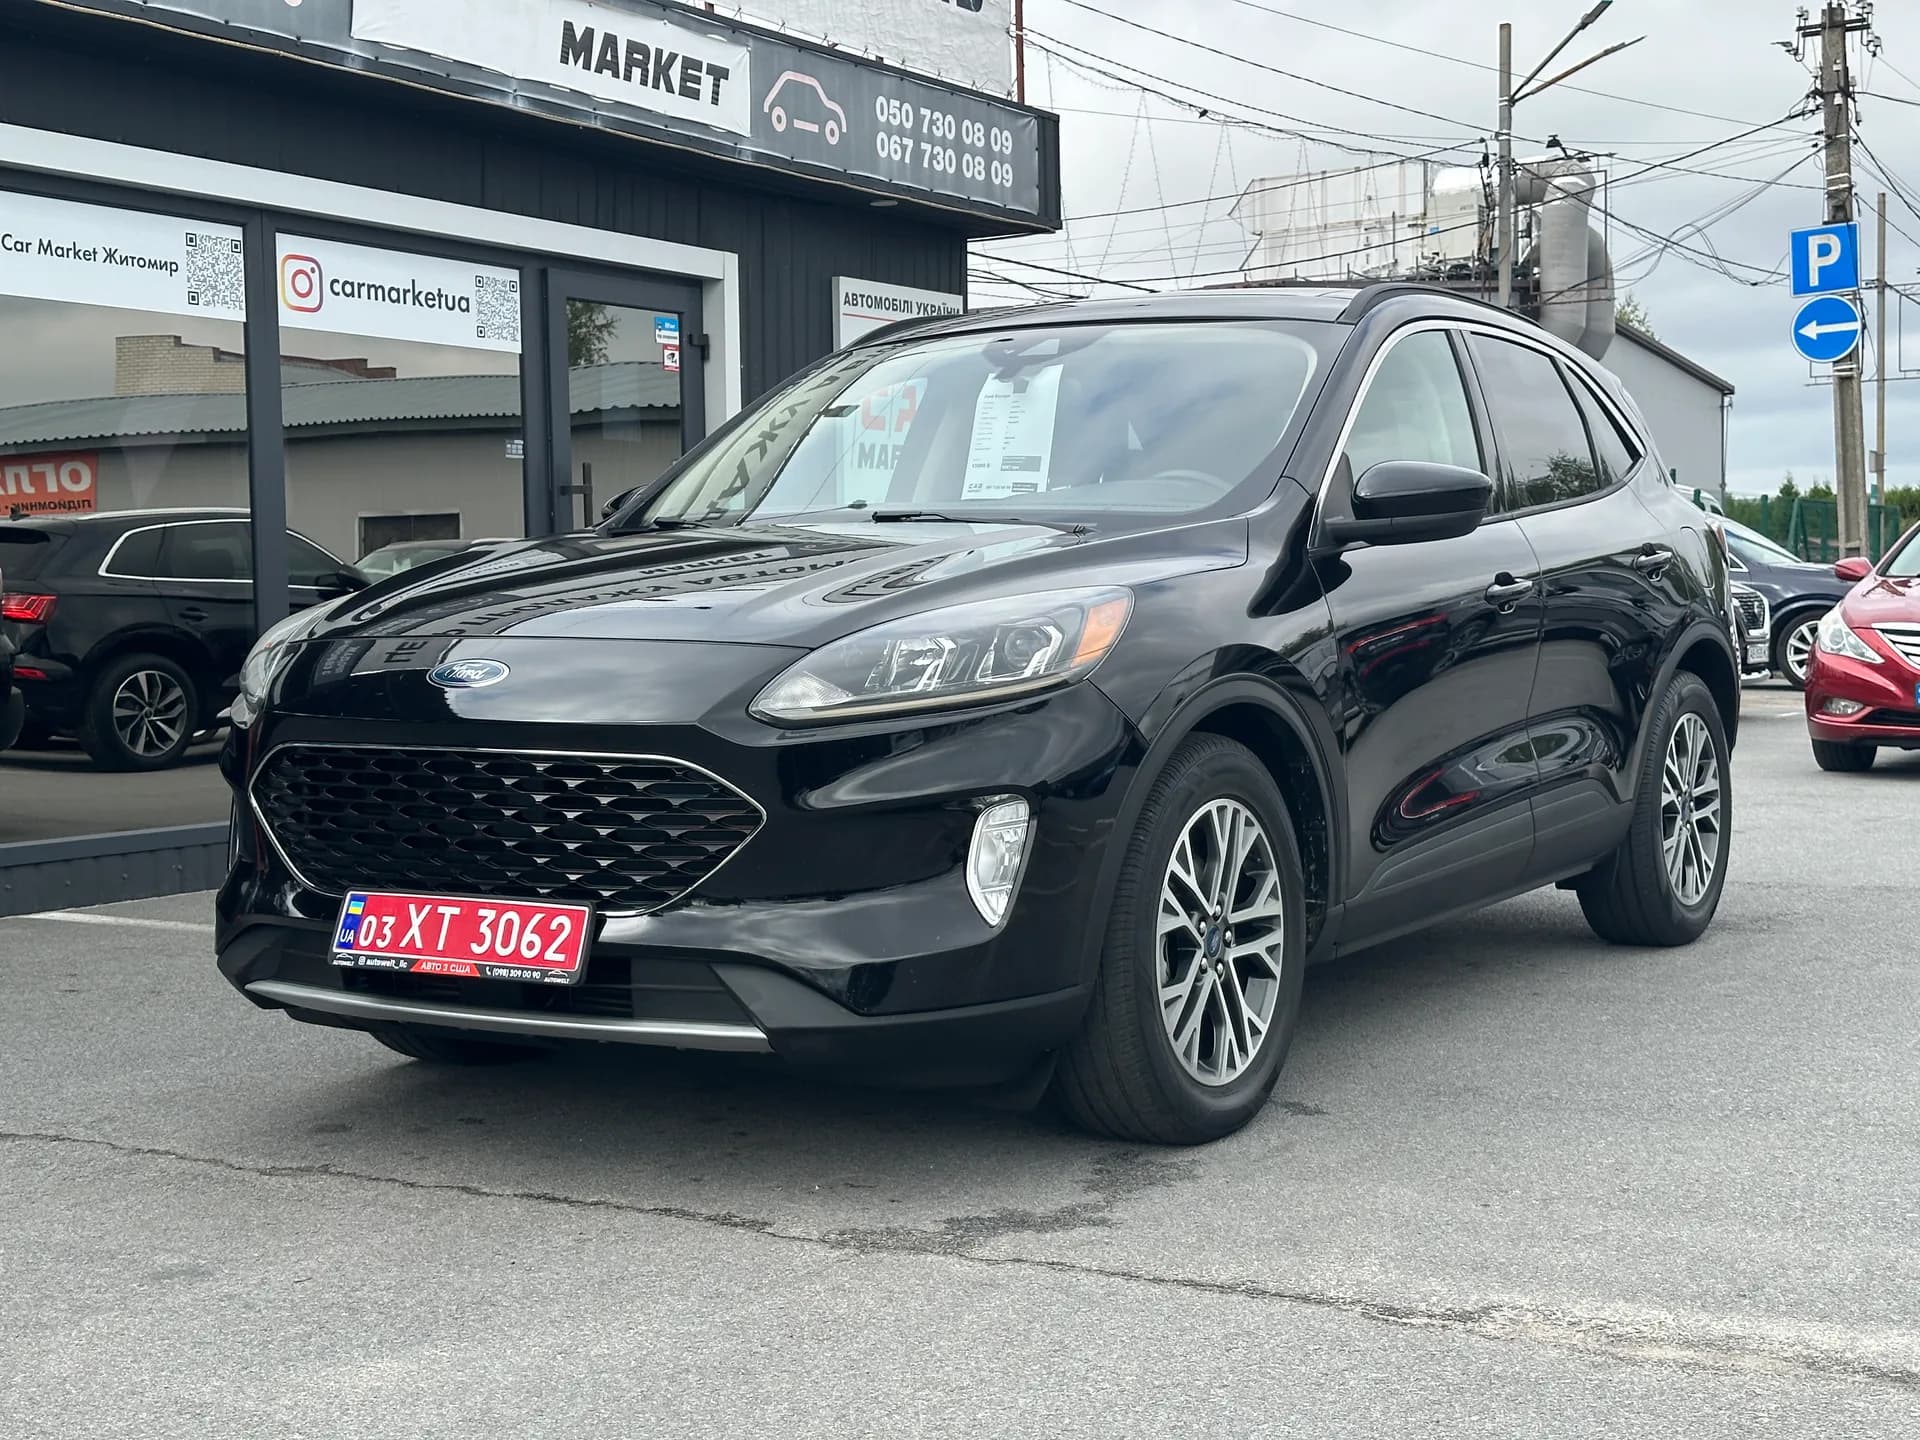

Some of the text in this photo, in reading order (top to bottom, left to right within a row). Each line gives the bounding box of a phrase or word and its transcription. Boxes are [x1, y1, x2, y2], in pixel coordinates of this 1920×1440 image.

[559, 19, 730, 106] MARKET
[875, 95, 1013, 155] 050 730 08 09
[876, 131, 1013, 188] 067 730 08 09
[1, 233, 179, 277] Car Market Житомир
[1807, 233, 1842, 287] P
[329, 278, 471, 314] carmarketua
[843, 291, 913, 314] АВТОМОБІЛІ
[444, 662, 491, 680] Ford
[340, 928, 355, 944] UA
[358, 903, 572, 962] 03 XT 3062
[420, 961, 442, 971] АВТО
[449, 964, 471, 974] США
[522, 970, 531, 979] 00
